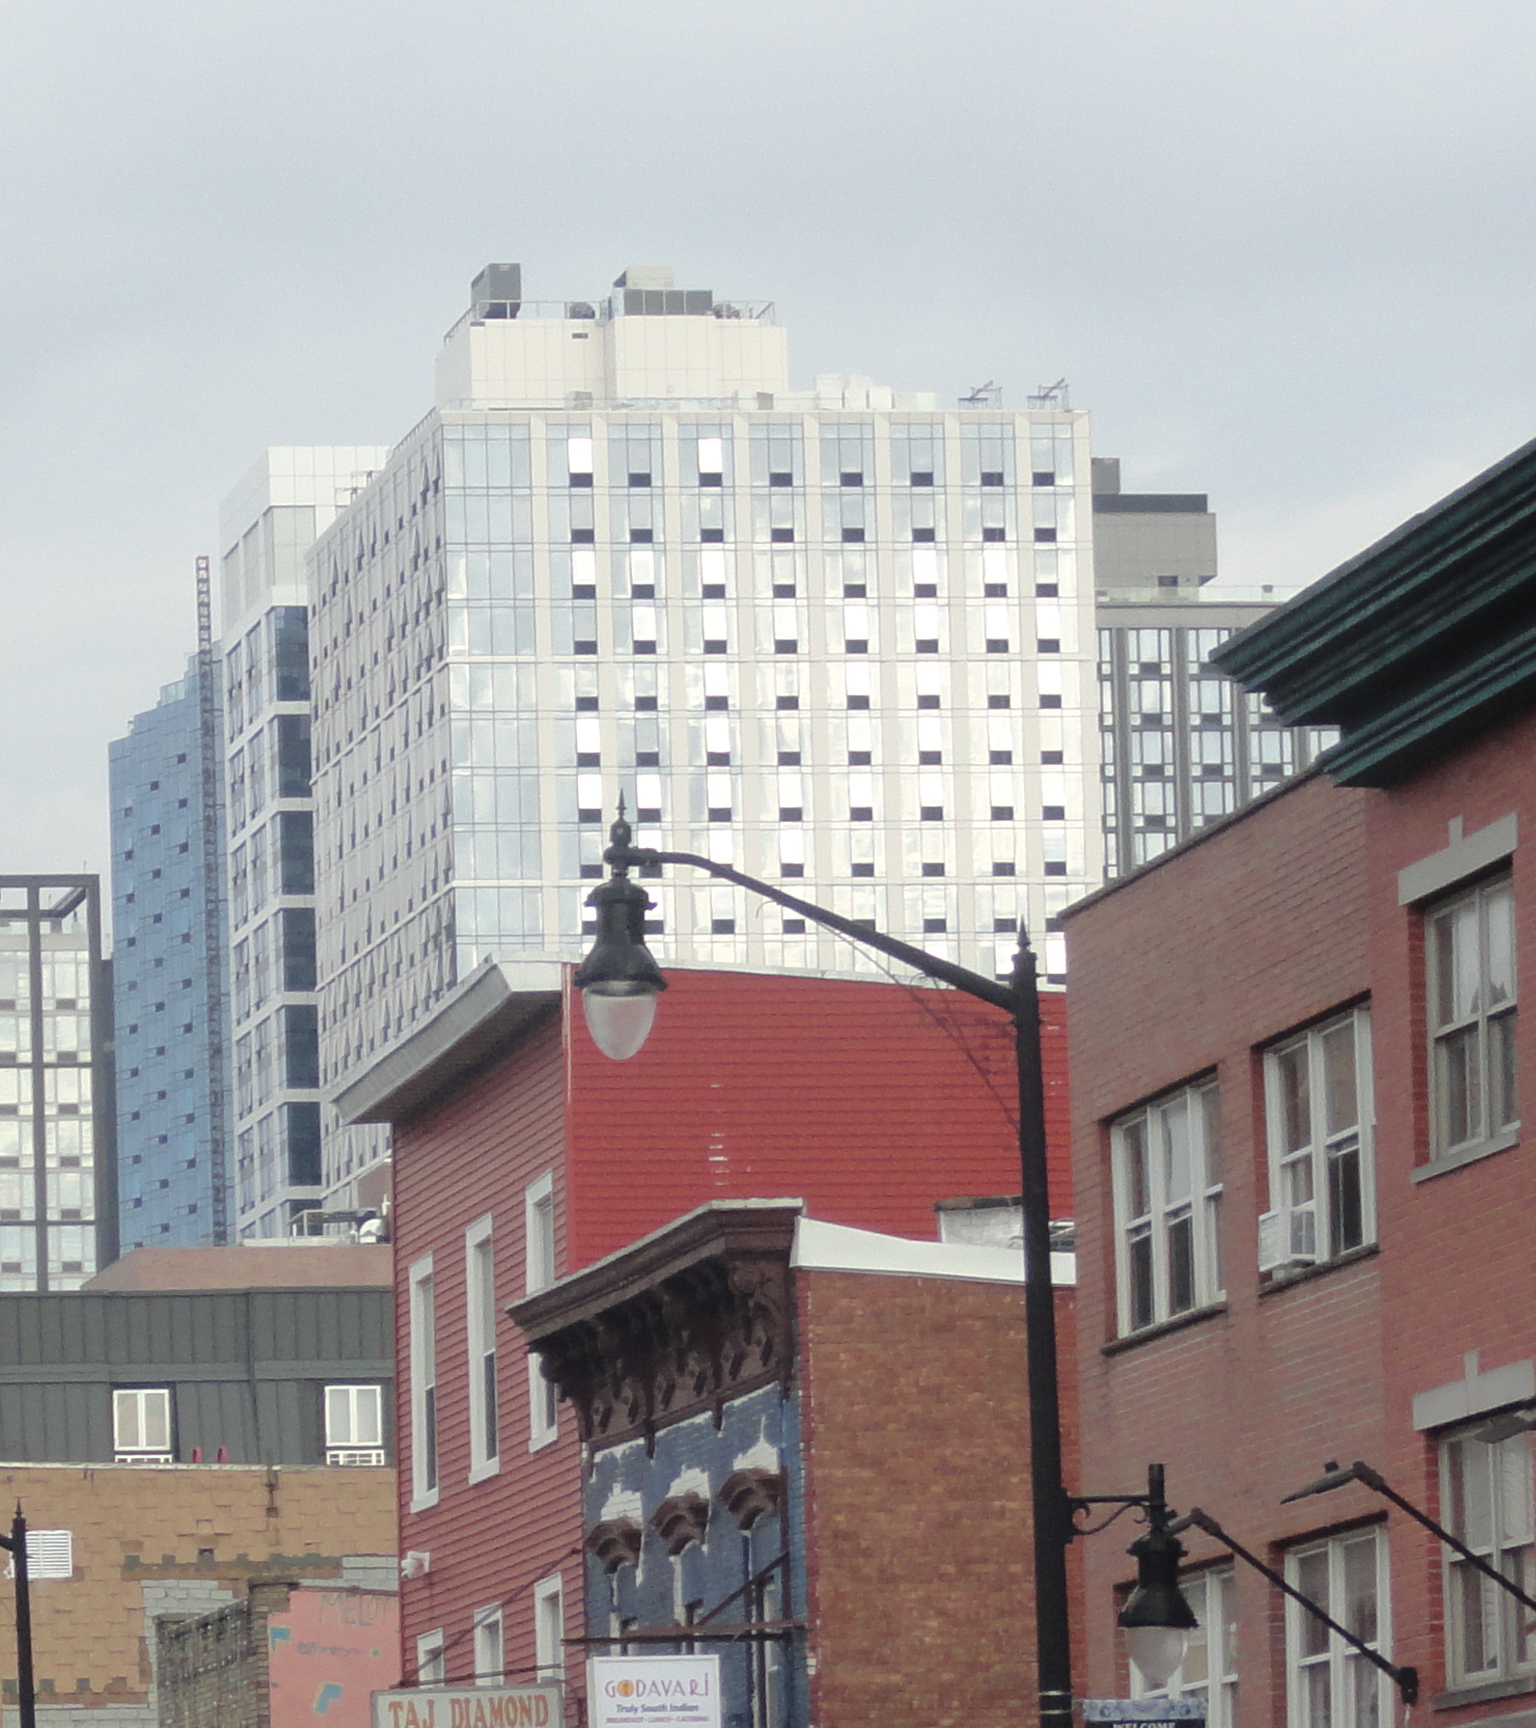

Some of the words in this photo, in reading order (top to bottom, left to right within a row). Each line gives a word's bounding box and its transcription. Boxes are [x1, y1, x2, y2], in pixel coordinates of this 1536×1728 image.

[605, 1672, 709, 1698] GODAVARI
[616, 1704, 638, 1714] Truly
[641, 1704, 667, 1712] South
[669, 1703, 699, 1712] Indian
